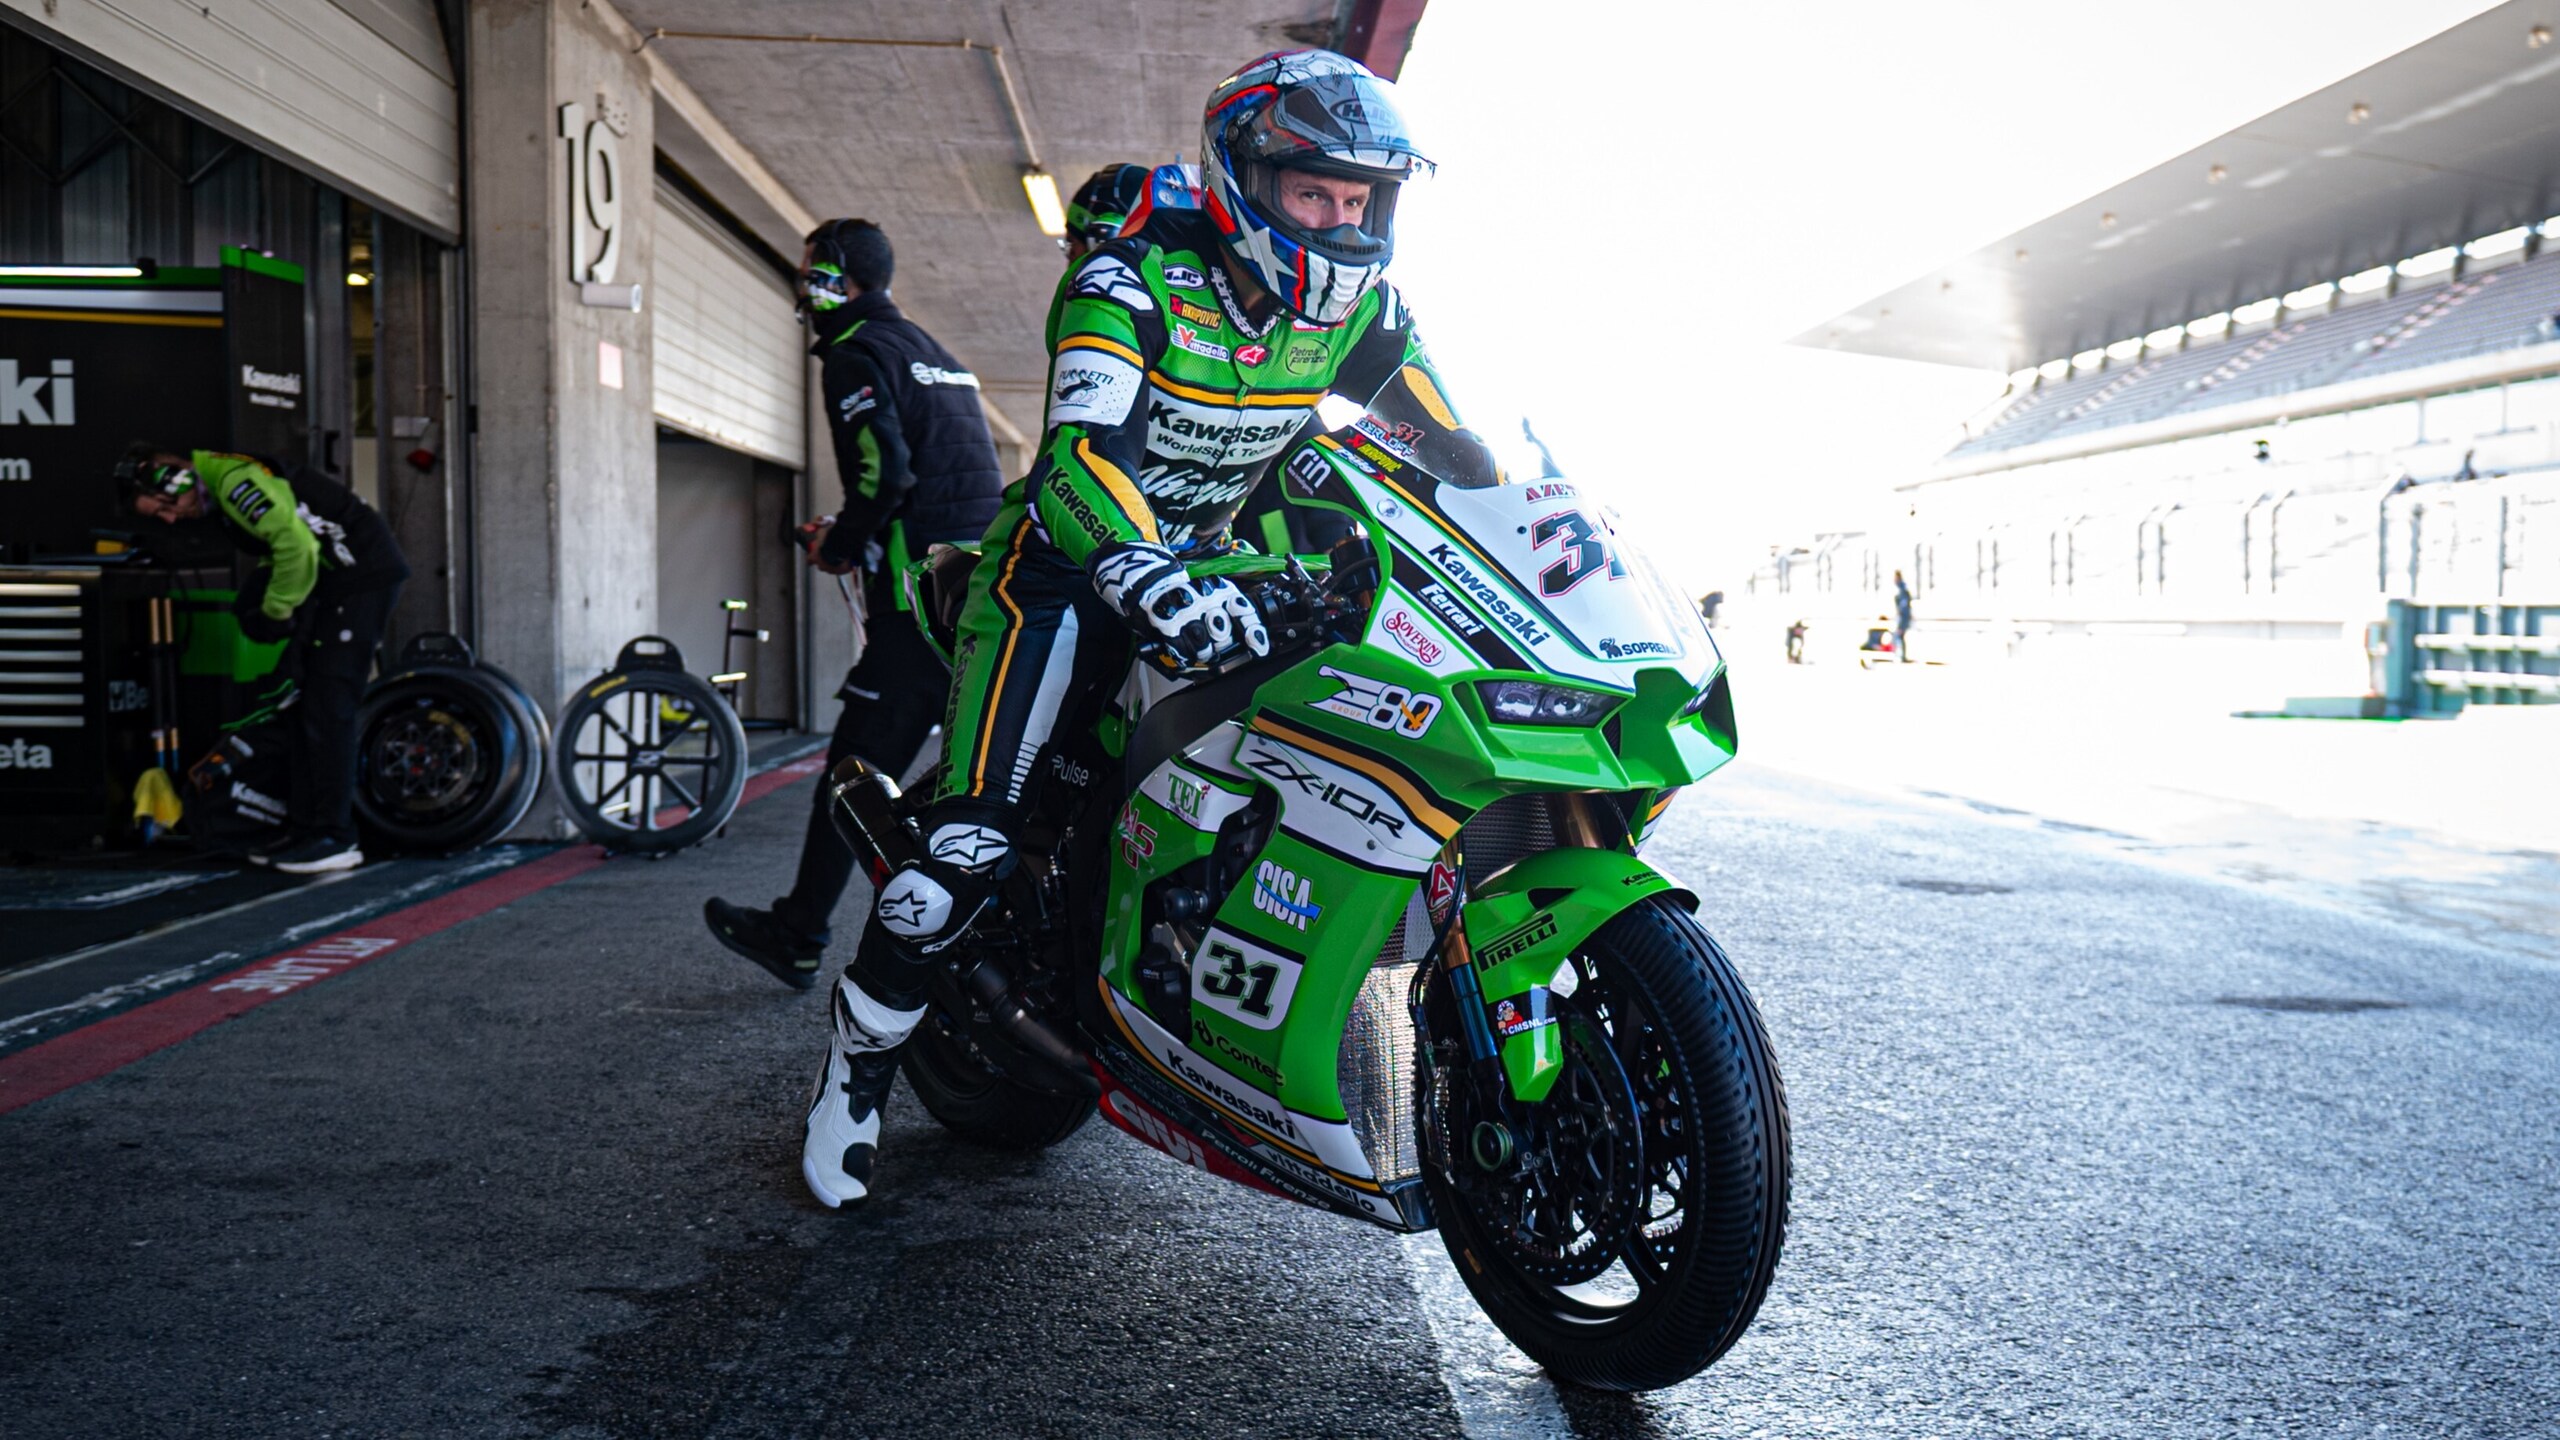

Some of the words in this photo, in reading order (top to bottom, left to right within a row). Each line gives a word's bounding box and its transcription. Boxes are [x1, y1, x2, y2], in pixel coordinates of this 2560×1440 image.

[557, 101, 622, 284] 19
[1210, 266, 1260, 339] alpinestars
[0, 359, 75, 425] ki
[1148, 401, 1308, 444] Kawasaki
[1294, 448, 1328, 488] rin
[1357, 417, 1416, 457] GERLOFF
[1045, 466, 1120, 544] Kawasa
[1140, 464, 1248, 511] Ninja
[1420, 583, 1485, 637] Ferrari
[1428, 543, 1551, 648] Kawasaki
[1621, 641, 1677, 656] SOPREM
[1051, 754, 1090, 787] Pulse
[1249, 748, 1406, 840] ZX-10R
[1252, 859, 1315, 932] CISA
[1475, 912, 1557, 973] PIRELLI
[1201, 940, 1280, 1020] 31
[1167, 1048, 1297, 1140] Kawasaki
[1216, 1034, 1286, 1088] Contec
[1200, 1128, 1260, 1174] Petroli
[1260, 1163, 1331, 1210] Firenze
